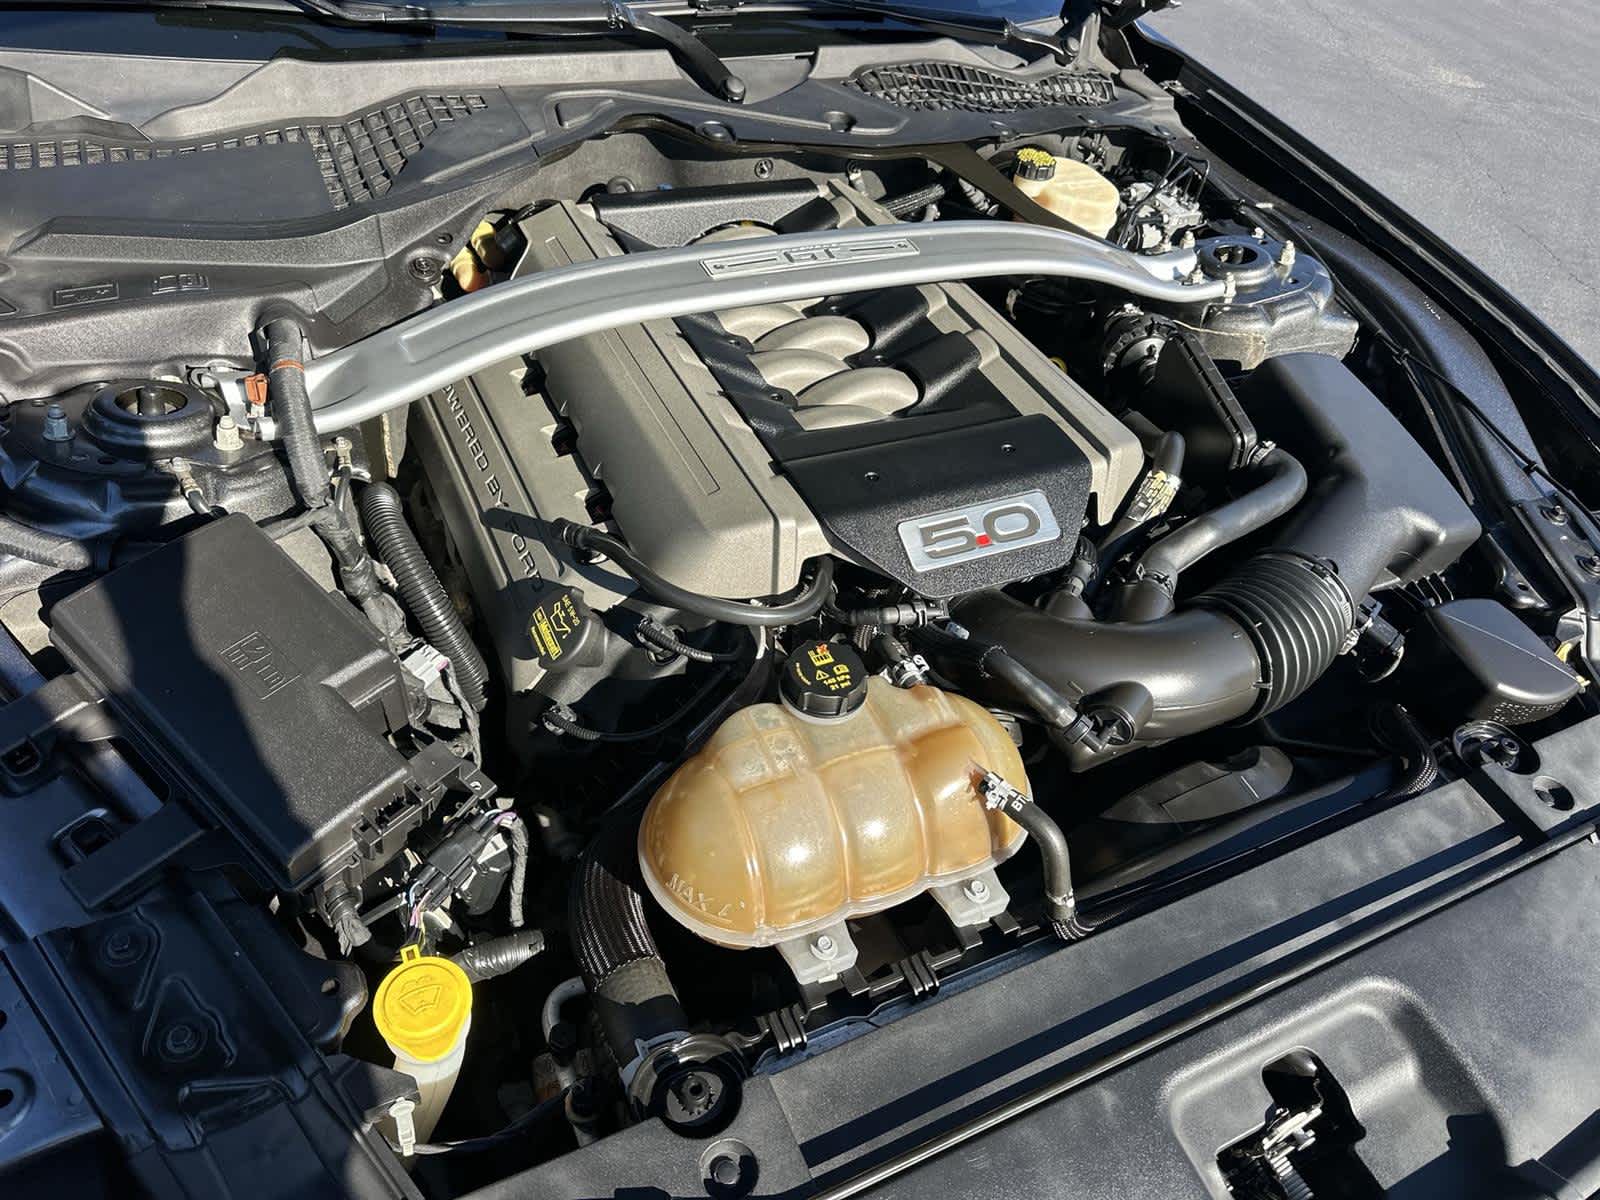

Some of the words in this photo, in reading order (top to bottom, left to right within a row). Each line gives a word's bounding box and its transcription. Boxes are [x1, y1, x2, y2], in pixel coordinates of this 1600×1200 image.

[442, 384, 490, 472] WERED
[485, 473, 510, 508] BY
[505, 517, 545, 592] FORD
[918, 502, 1042, 559] 5.0
[665, 873, 716, 912] MAX
